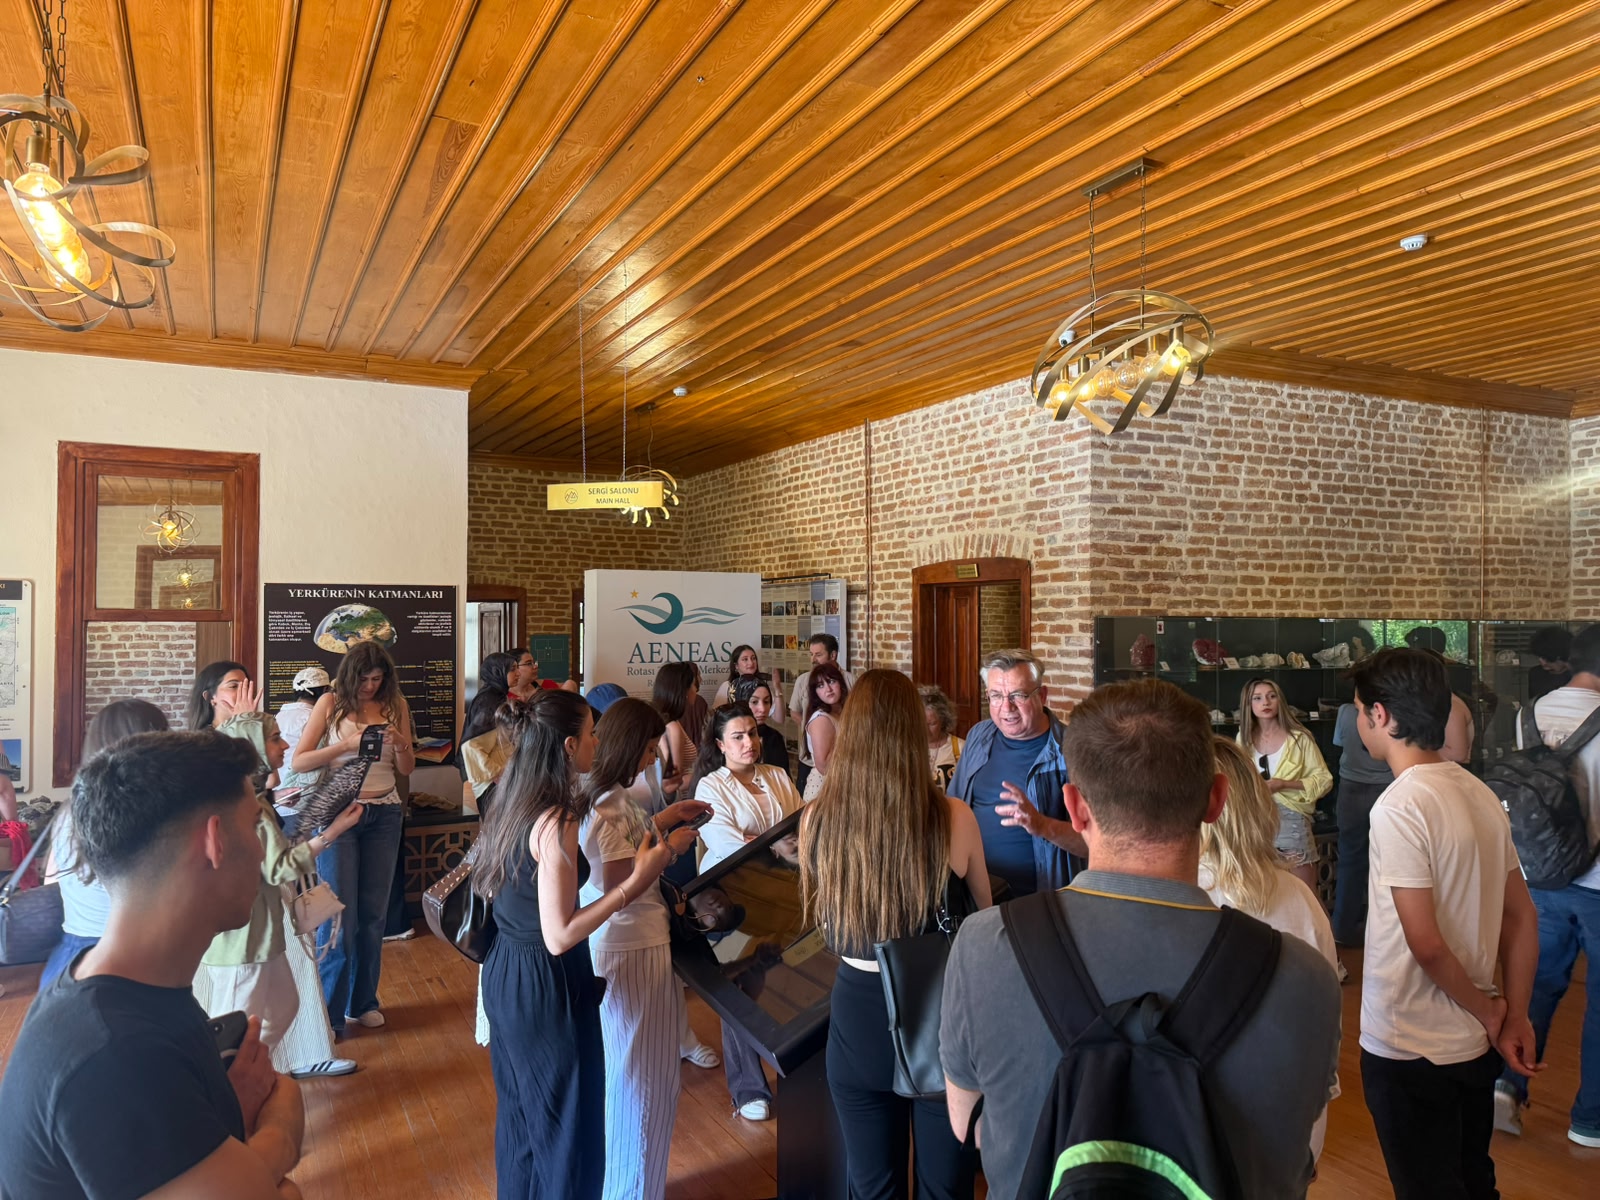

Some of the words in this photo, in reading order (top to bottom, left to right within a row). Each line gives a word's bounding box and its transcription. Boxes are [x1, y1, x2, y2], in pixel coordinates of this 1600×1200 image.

[588, 487, 608, 495] SERGİ
[610, 487, 639, 495] SALONU
[288, 587, 366, 599] YERKÜRENİN
[368, 590, 443, 599] KATMANLARI
[627, 641, 732, 664] AENEAS
[626, 666, 655, 676] Rotası
[700, 664, 730, 674] Merkez
